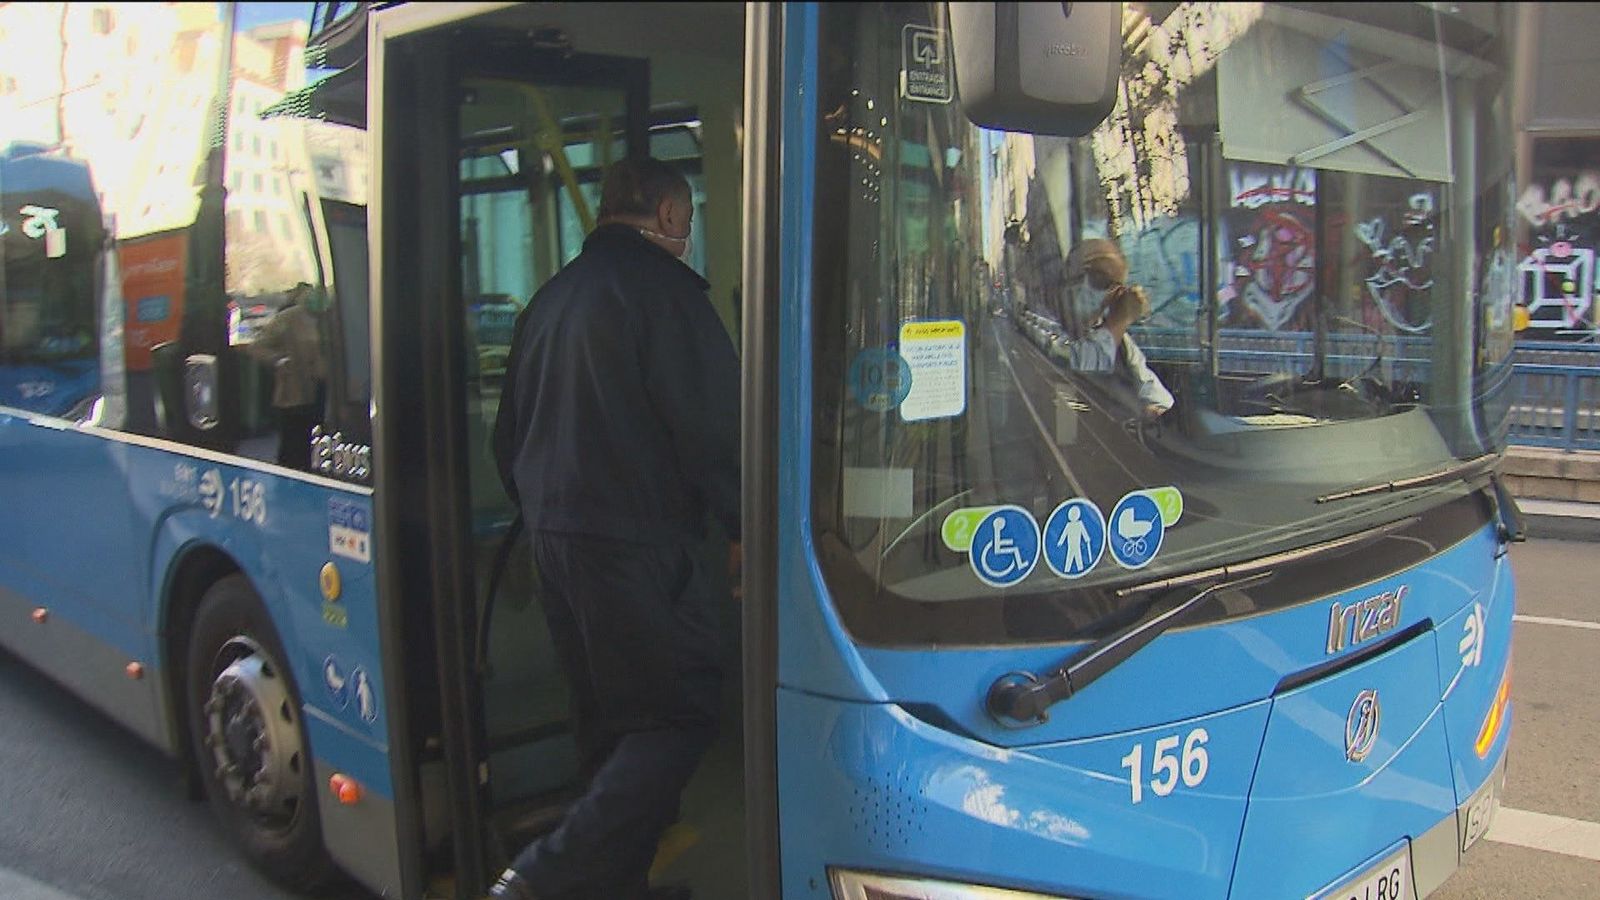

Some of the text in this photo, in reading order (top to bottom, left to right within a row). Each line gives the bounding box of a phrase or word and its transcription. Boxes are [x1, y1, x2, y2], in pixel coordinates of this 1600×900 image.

[229, 476, 267, 526] 156
[1166, 495, 1177, 515] 2
[954, 515, 969, 541] 2
[1326, 584, 1410, 654] Irizar
[1121, 727, 1209, 804] 156
